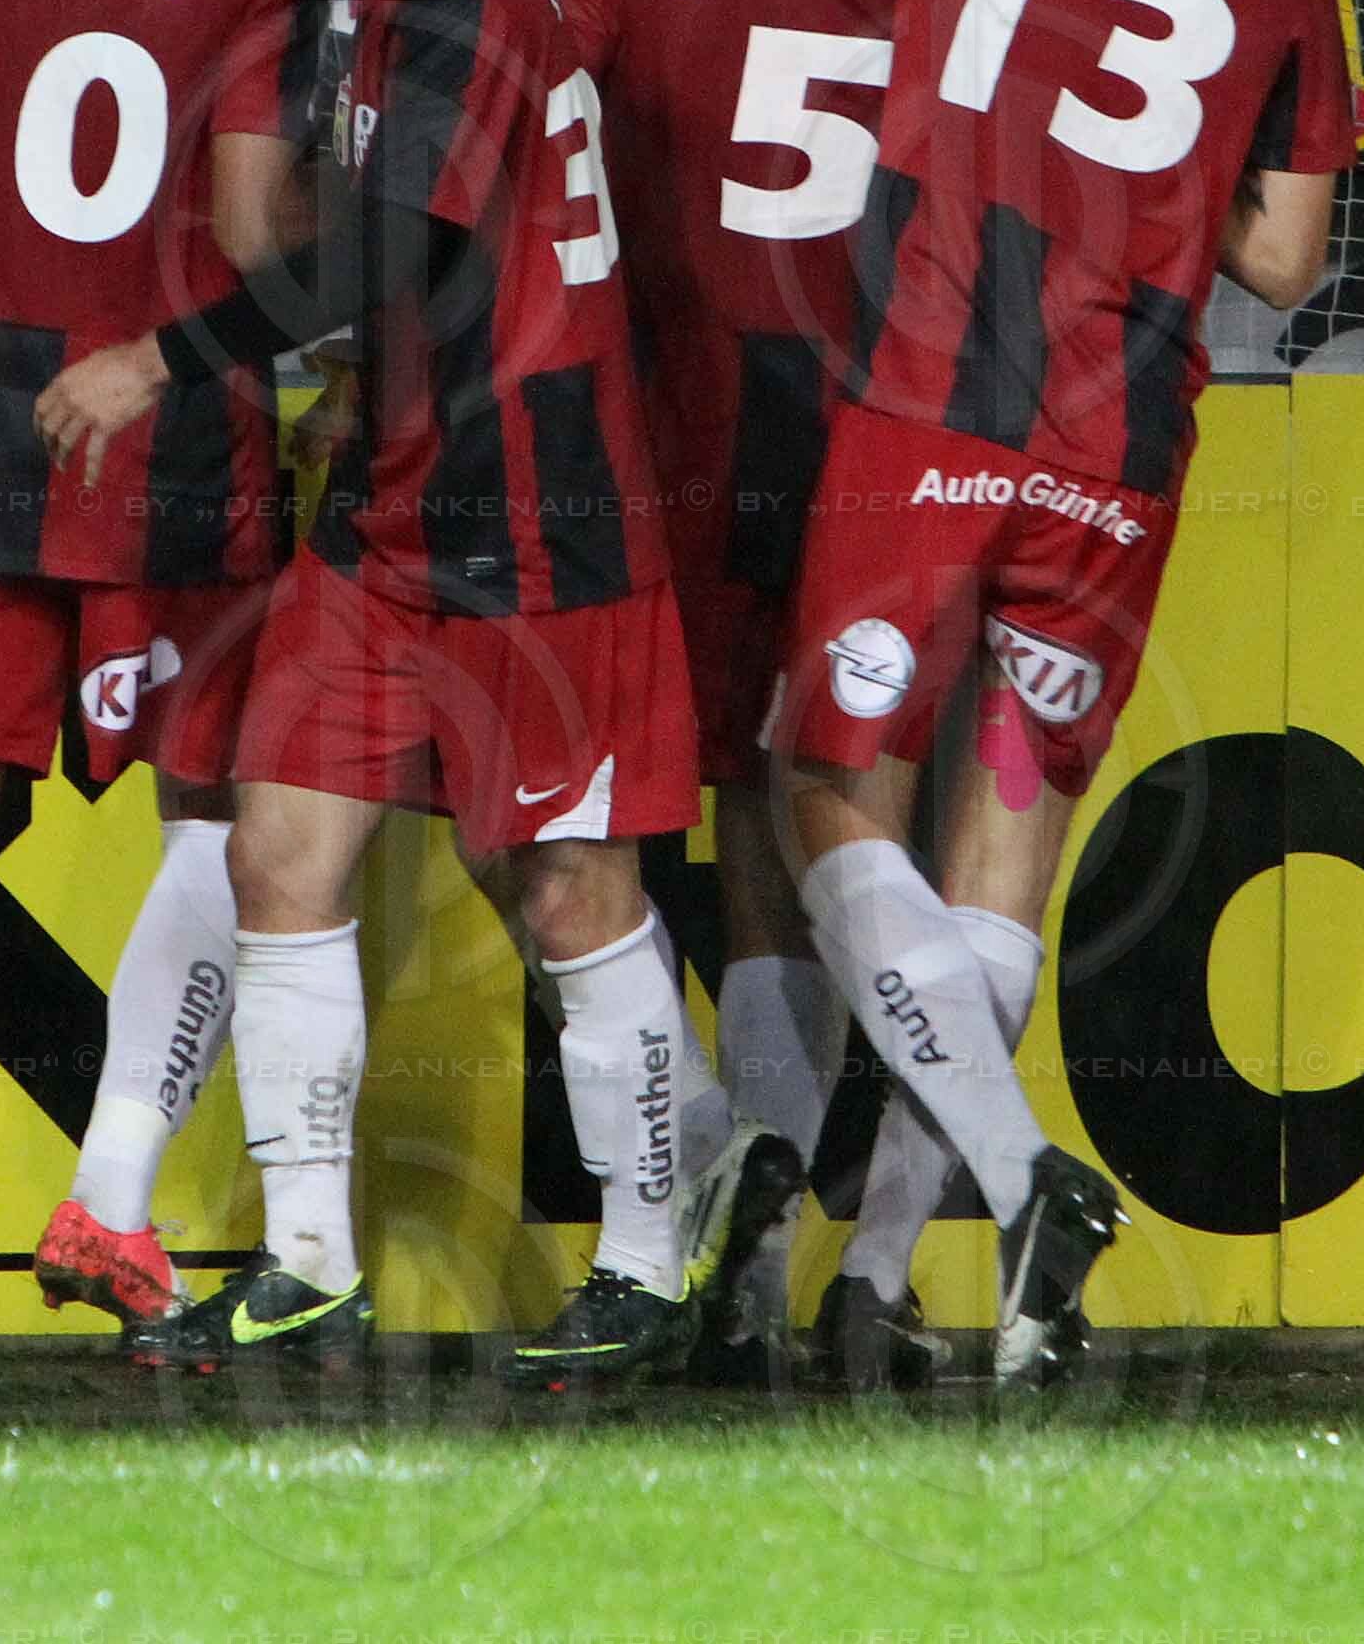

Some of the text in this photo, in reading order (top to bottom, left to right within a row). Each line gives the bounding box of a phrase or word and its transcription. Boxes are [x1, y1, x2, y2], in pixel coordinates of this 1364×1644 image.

[720, 25, 893, 240] 5
[911, 468, 1015, 504] Auto
[875, 969, 949, 1067] Auto
[637, 1029, 673, 1205] Günther
